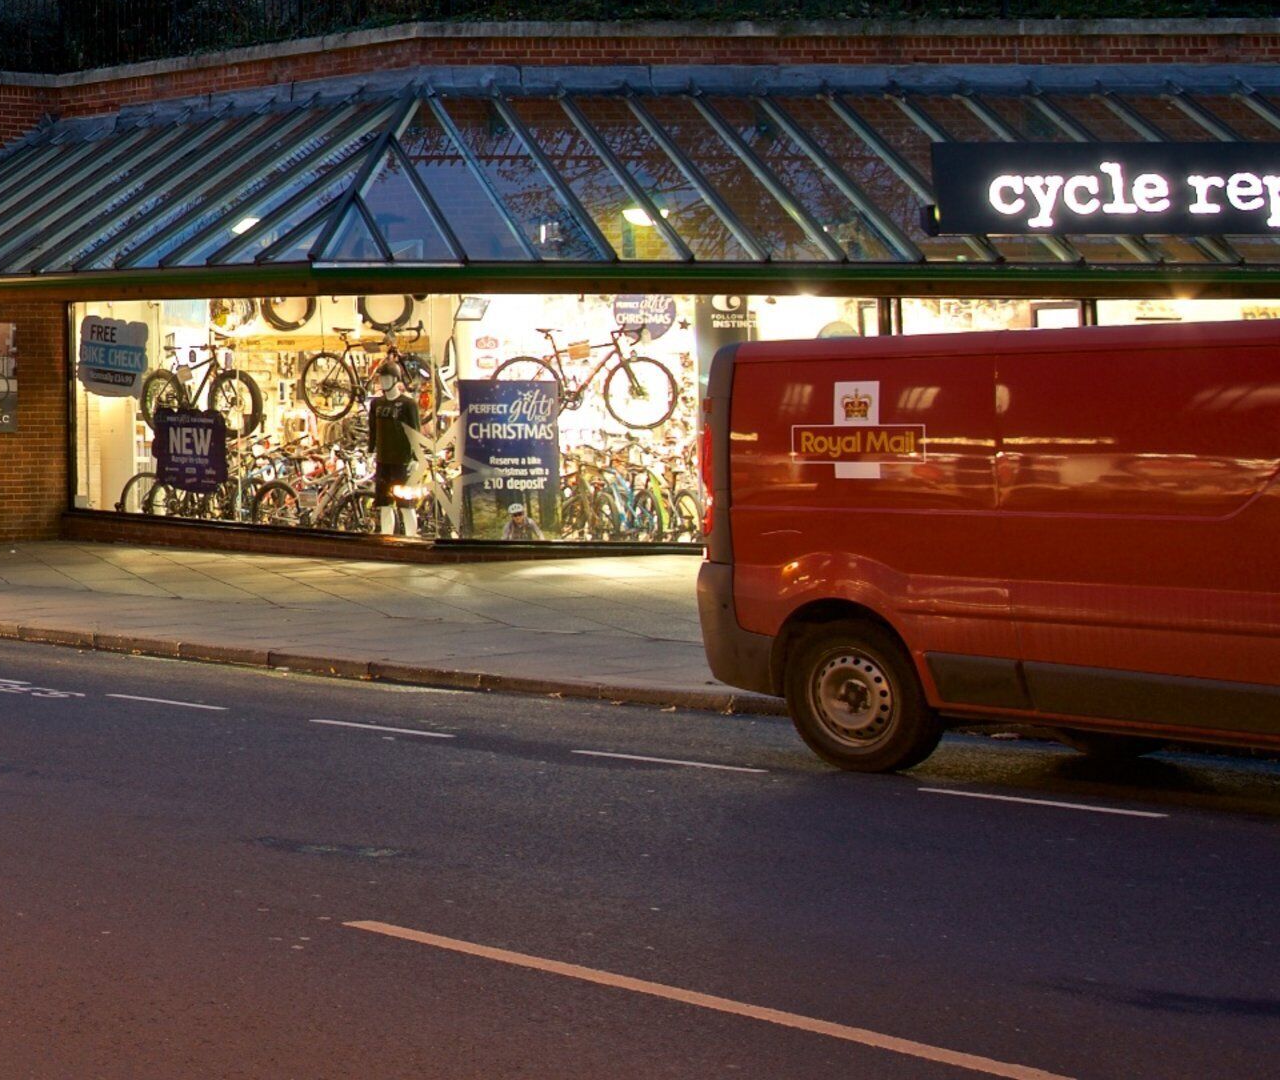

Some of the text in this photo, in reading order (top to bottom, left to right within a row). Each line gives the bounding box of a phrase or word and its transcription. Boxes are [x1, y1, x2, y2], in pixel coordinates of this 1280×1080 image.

[988, 162, 1171, 228] cycle
[90, 324, 117, 344] FREE
[81, 345, 142, 369] BIKE CHECK
[468, 389, 554, 423] PERFECT gifts
[168, 426, 213, 456] NEW
[468, 423, 555, 440] CHRISTMAS
[800, 431, 915, 458] Royal Mail
[484, 476, 504, 490] £10
